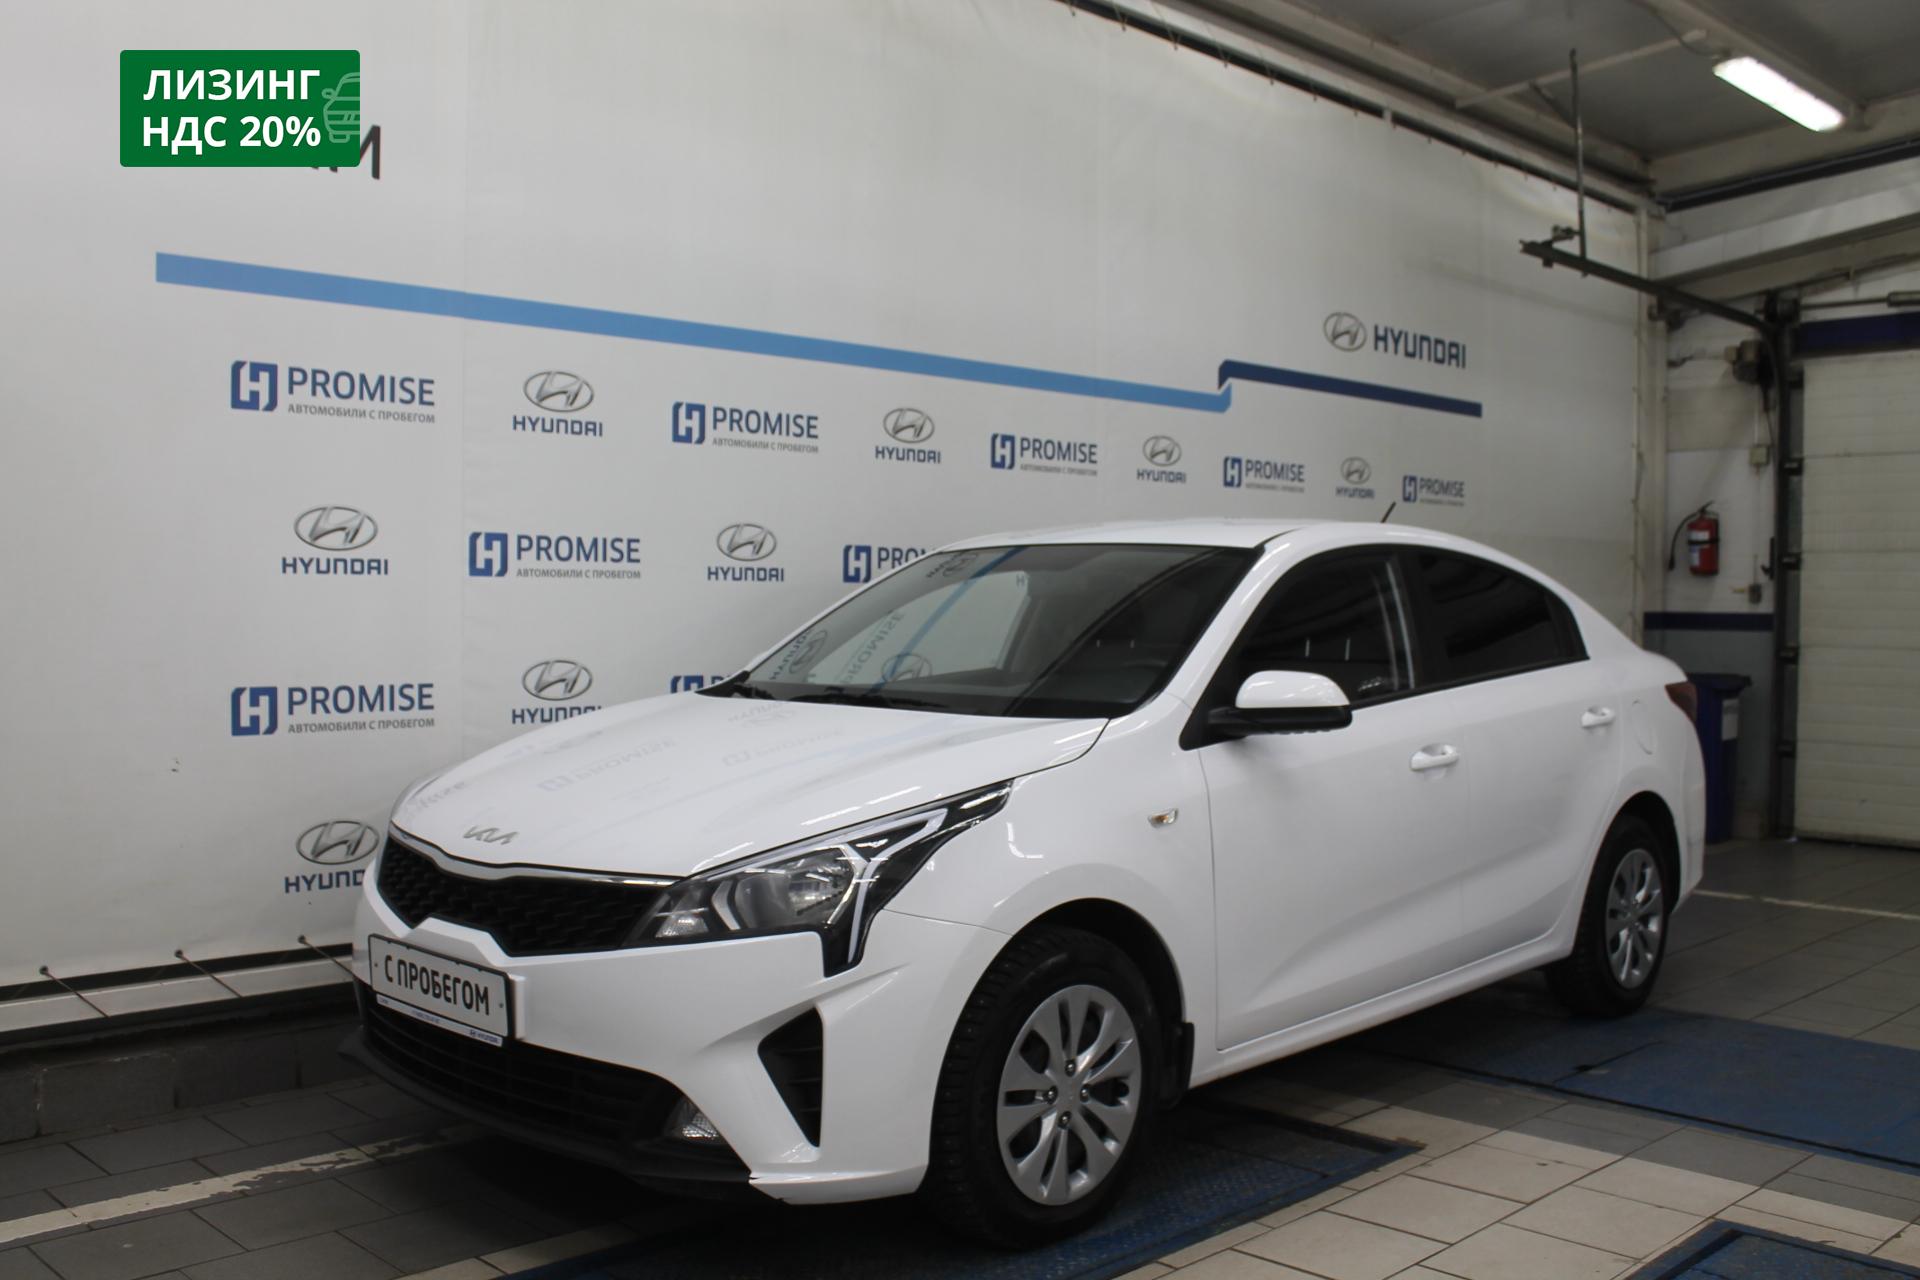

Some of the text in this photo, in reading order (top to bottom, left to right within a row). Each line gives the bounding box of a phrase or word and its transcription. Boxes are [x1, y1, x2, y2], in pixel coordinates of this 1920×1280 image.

[1374, 325, 1466, 369] HYUNDAI
[288, 366, 435, 406] PROMISE
[288, 403, 367, 419] АВТОМОБИЛИ
[378, 410, 435, 424] ПРОБЕГОМ
[713, 406, 818, 439] PROMISE
[512, 414, 602, 437] HYUNDAI
[875, 445, 941, 464] HYUNDAI
[1020, 436, 1098, 464] PROMISE
[1137, 468, 1186, 484] HYUNDAI
[1245, 459, 1305, 483] PROMISE
[1335, 487, 1375, 500] HYUNDAI
[1419, 477, 1465, 498] PROMISE
[516, 534, 641, 563] PROMISE
[281, 556, 389, 576] HYUNDAI
[516, 568, 582, 579] АВТОМОБИЛИ
[592, 569, 641, 579] ПРОБЕГОМ
[707, 565, 785, 583] HYUNDAI
[288, 683, 435, 715] PROMISE
[288, 721, 367, 734] АВТОМОБИЛИ
[378, 718, 435, 730] ПРОБЕГОМ
[284, 869, 366, 893] HYUND
[385, 955, 489, 1016] С ПРОБЕГОМ
